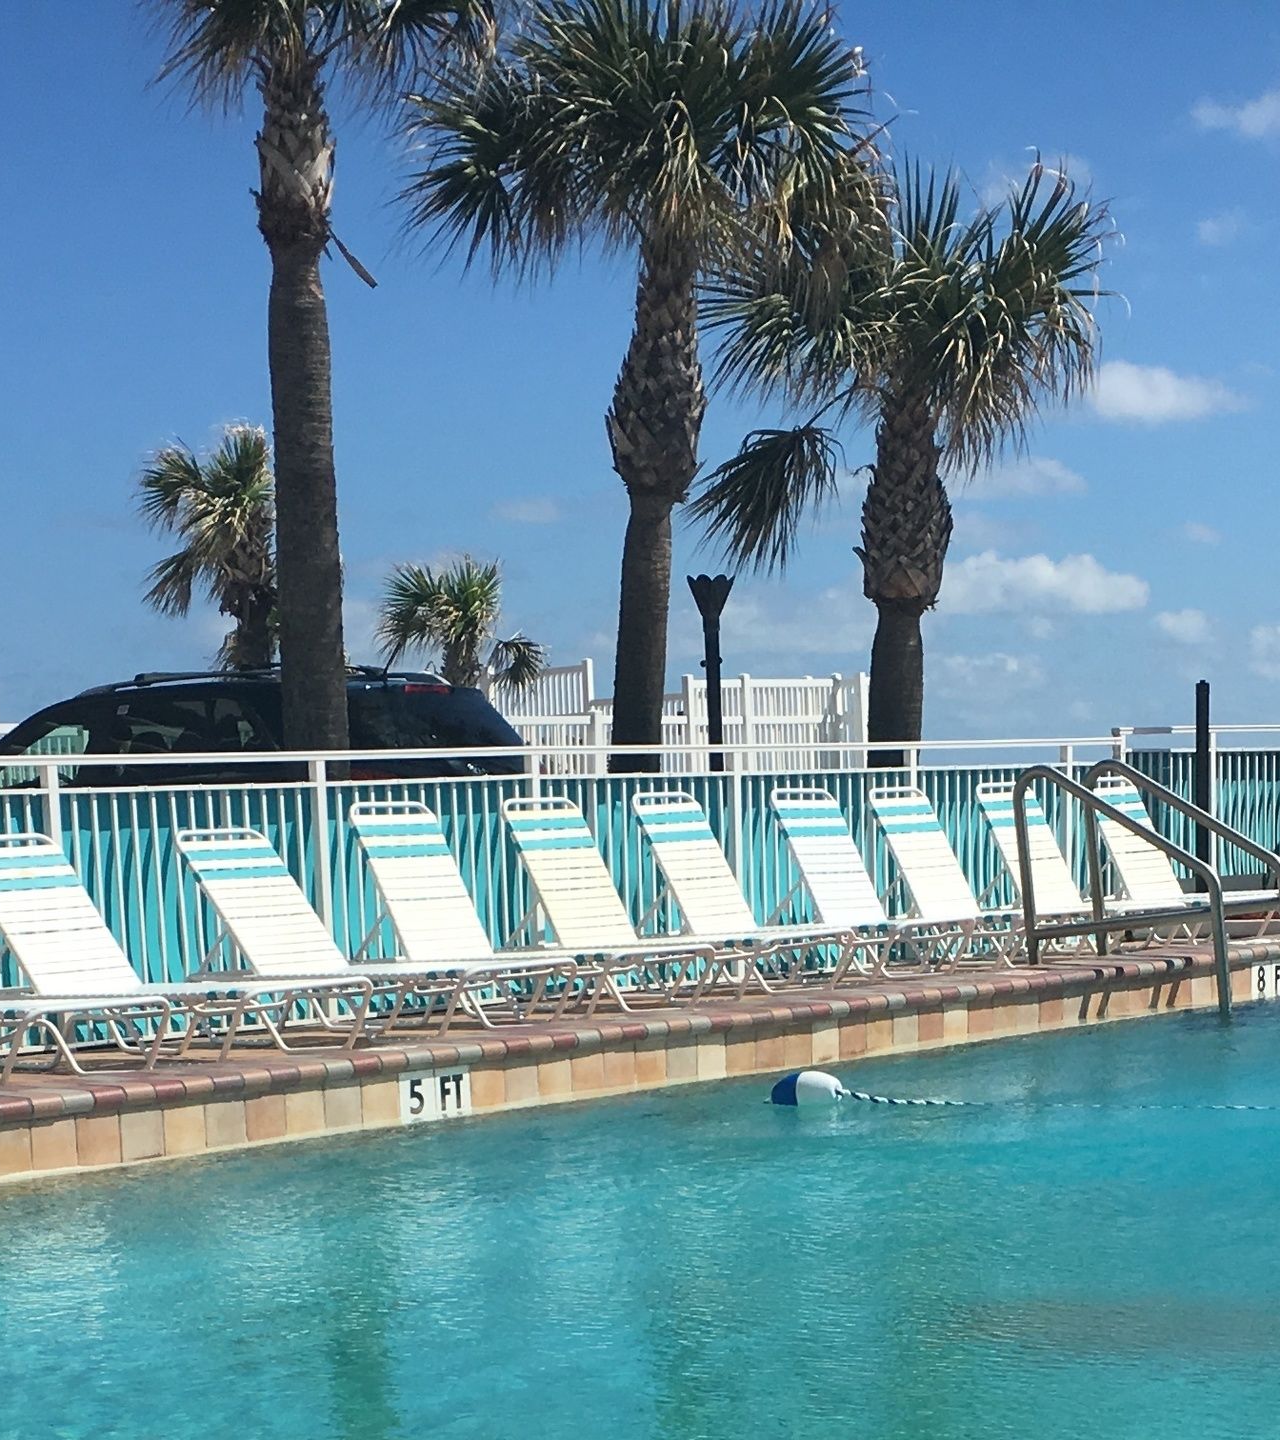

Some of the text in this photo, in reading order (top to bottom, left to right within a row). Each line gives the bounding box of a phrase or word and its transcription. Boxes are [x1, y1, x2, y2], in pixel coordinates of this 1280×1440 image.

[1257, 966, 1266, 993] 8
[410, 1073, 463, 1115] 5 FT
